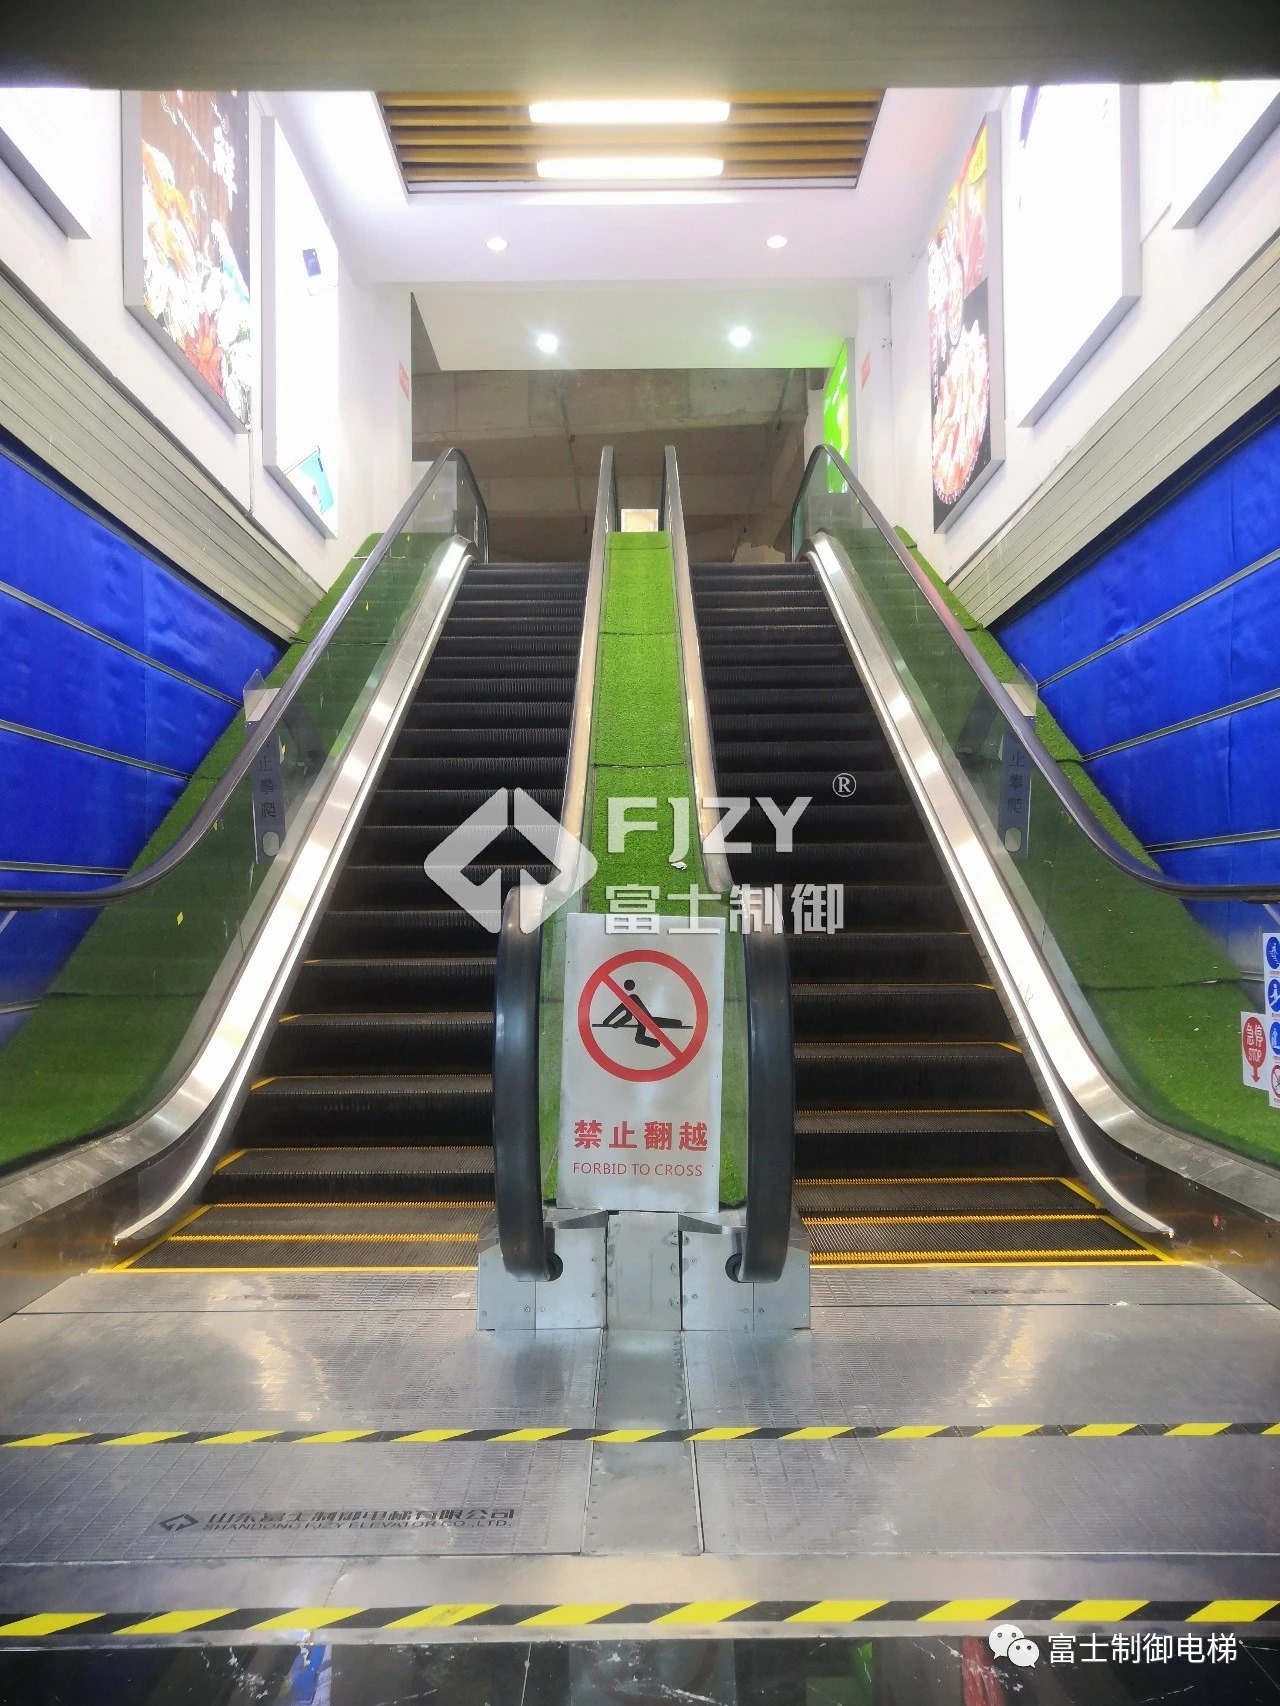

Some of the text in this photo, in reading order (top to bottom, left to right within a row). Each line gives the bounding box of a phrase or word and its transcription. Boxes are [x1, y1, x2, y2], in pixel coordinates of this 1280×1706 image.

[257, 741, 276, 819] 止攀爬
[1246, 1022, 1264, 1048] 急停
[1248, 1048, 1262, 1063] STOP
[573, 1119, 708, 1152] 禁止翻越
[573, 1162, 703, 1177] FORBID TO CROSS
